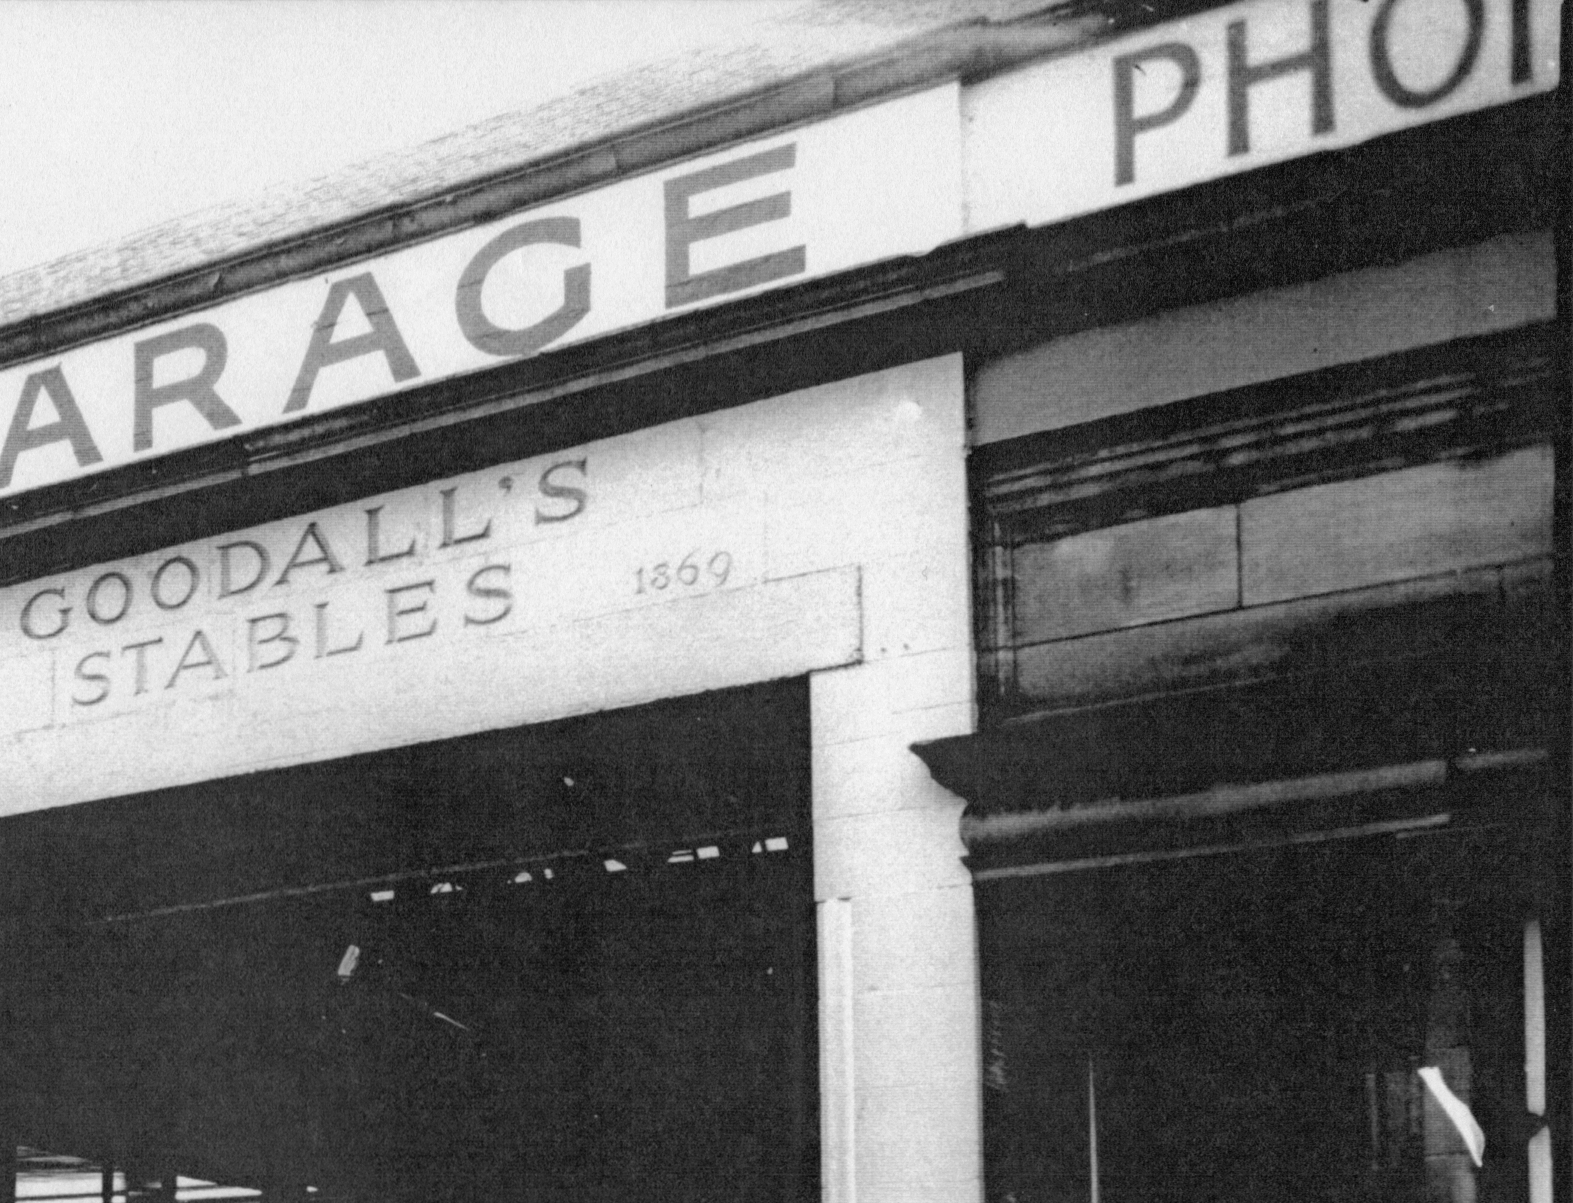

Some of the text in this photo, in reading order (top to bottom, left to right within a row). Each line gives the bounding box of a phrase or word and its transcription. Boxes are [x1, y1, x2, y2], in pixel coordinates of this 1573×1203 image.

[1112, 0, 1532, 188] PHO
[18, 455, 590, 641] GOODALL'S
[631, 549, 734, 597] 1869
[69, 562, 516, 708] STABLES
